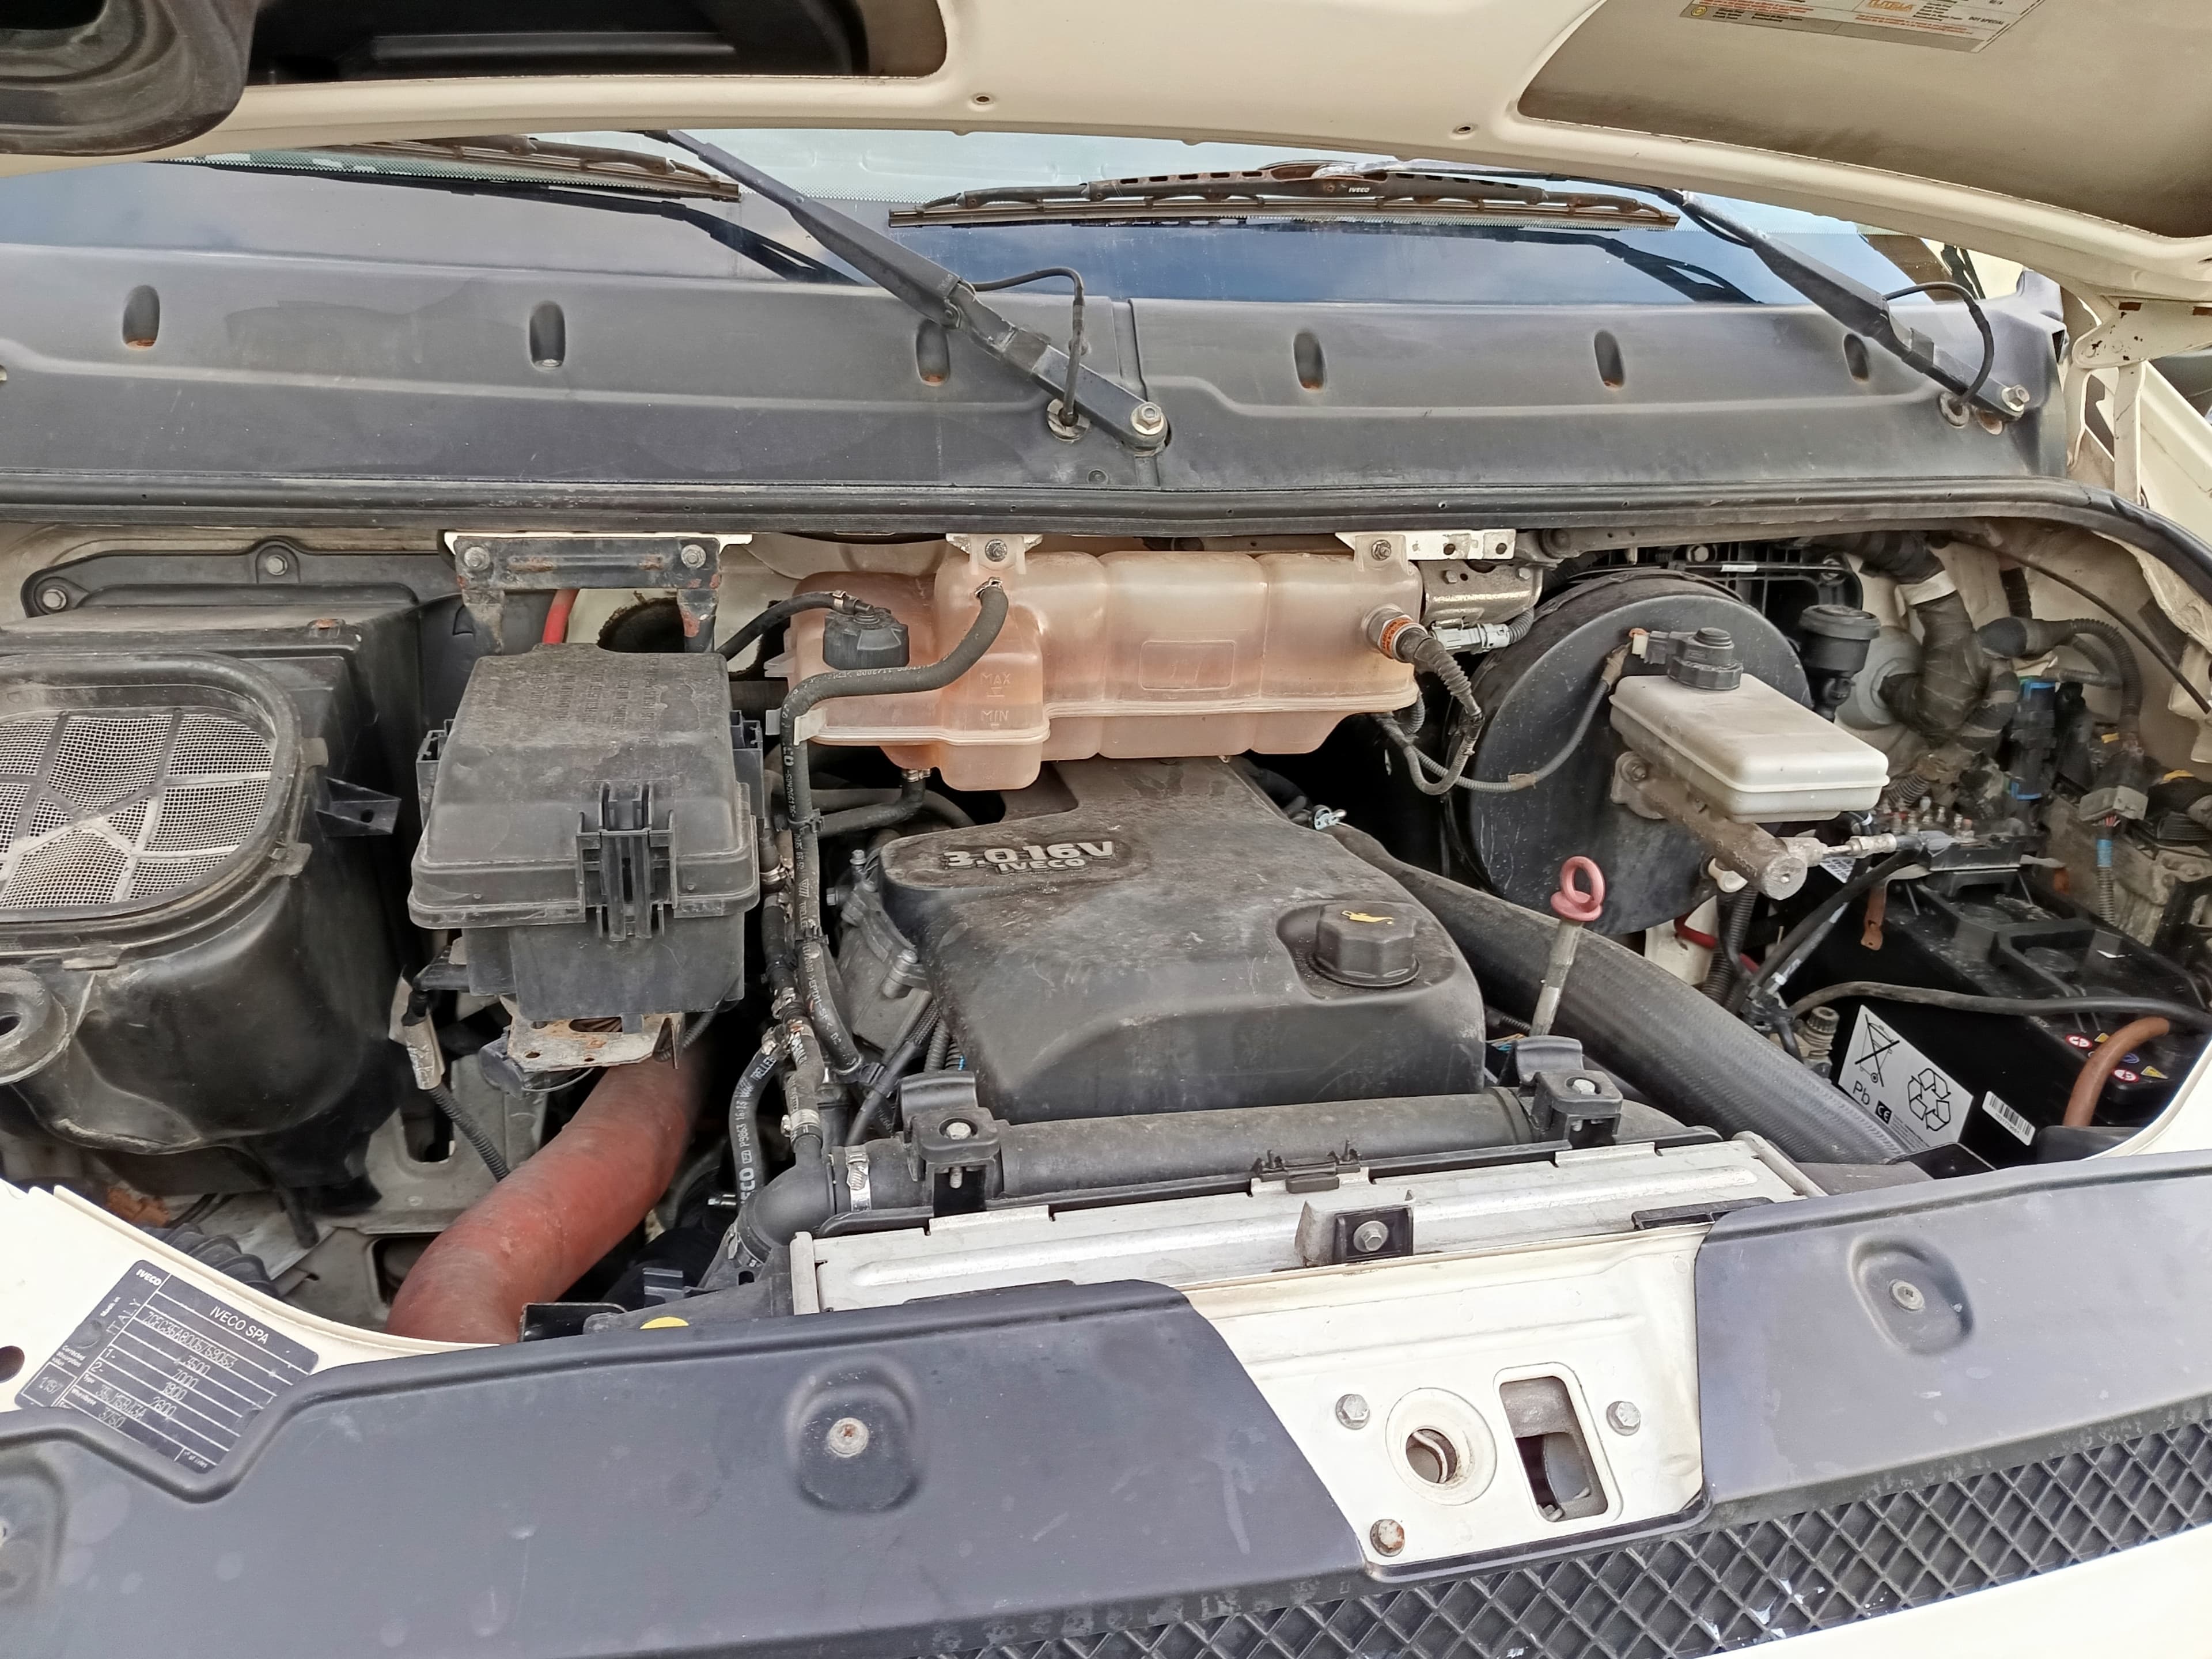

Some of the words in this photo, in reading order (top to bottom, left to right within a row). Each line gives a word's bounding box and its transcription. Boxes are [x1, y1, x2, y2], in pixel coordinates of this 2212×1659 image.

[980, 672, 1012, 685] MAX
[981, 709, 1009, 722] MIN
[997, 858, 1086, 874] IVECO
[1853, 1080, 1870, 1105] Pb
[136, 1268, 162, 1286] IVECO
[106, 1298, 141, 1335] ITALY
[209, 1306, 247, 1336] IVECO
[245, 1324, 271, 1345] SPA
[186, 1355, 211, 1376] 3500
[91, 1361, 105, 1374] 2-
[151, 1396, 177, 1419] 2600
[173, 1369, 199, 1390] 7000
[164, 1381, 187, 1402] 1900
[97, 1410, 126, 1429] 3750
